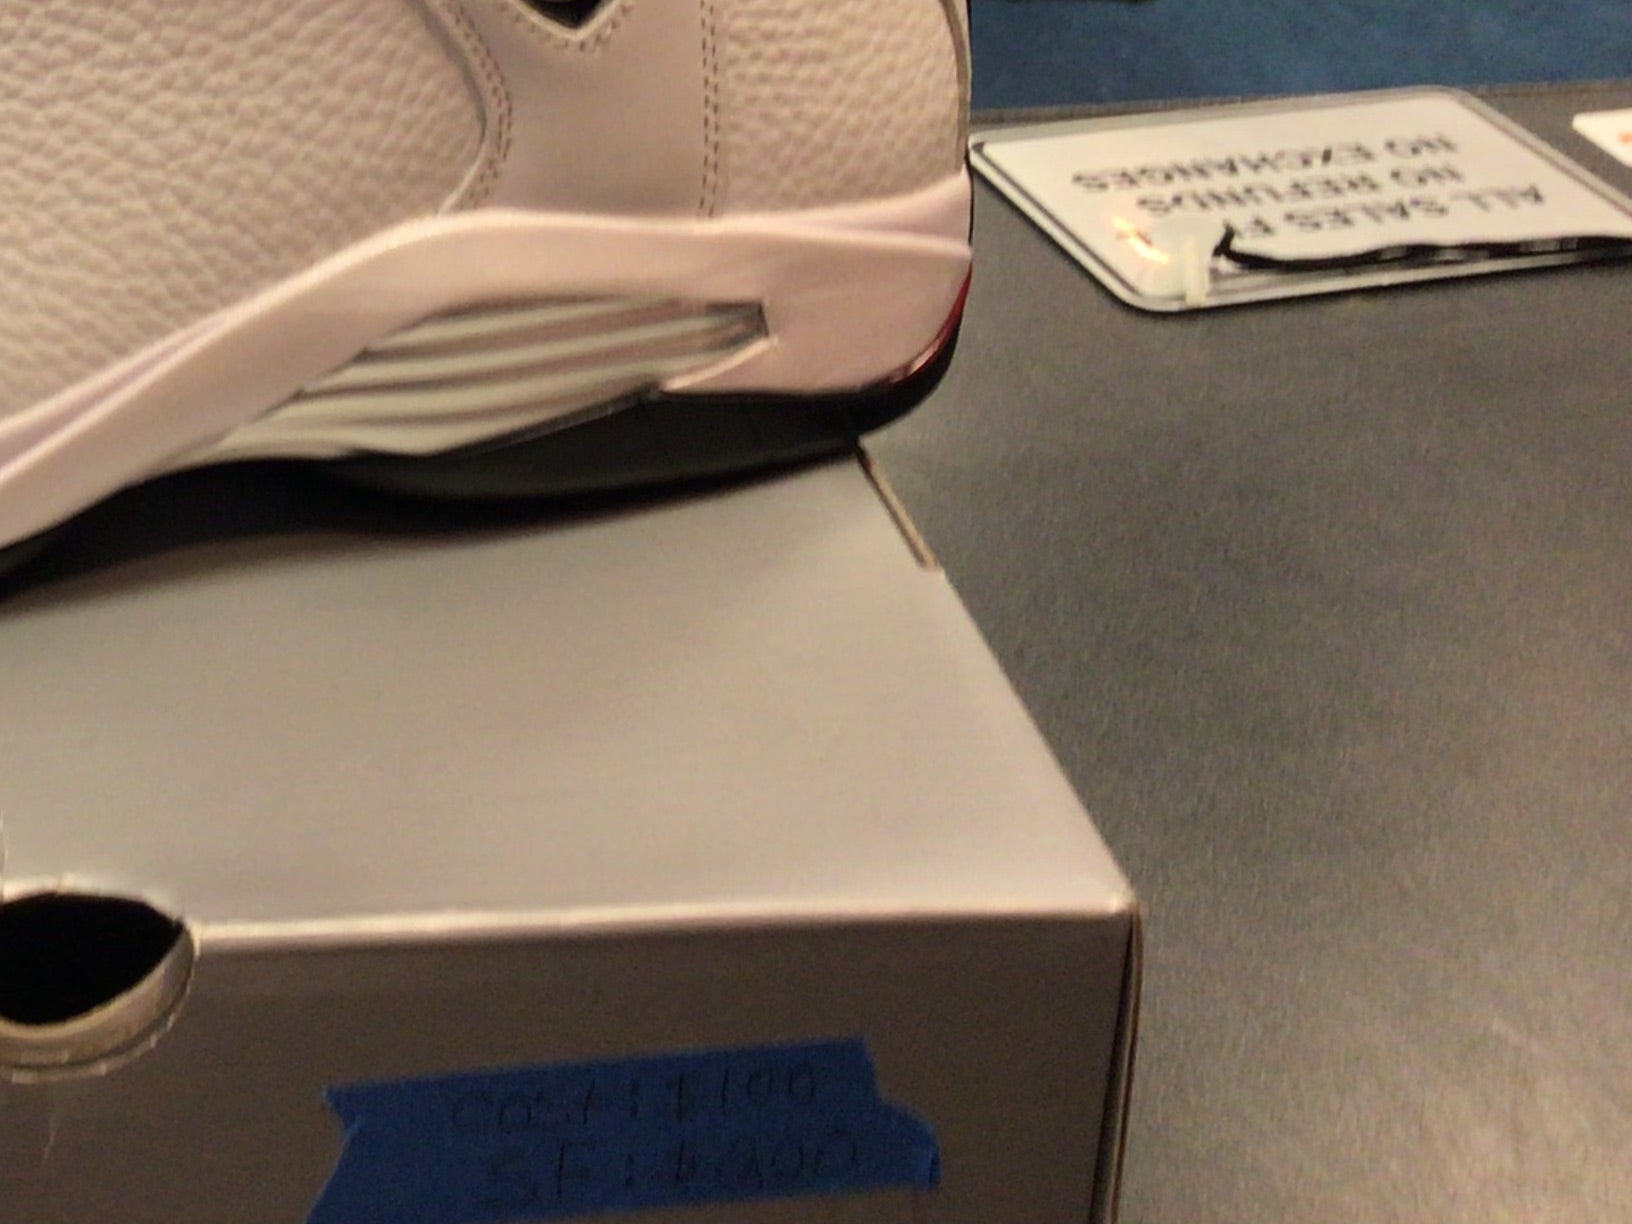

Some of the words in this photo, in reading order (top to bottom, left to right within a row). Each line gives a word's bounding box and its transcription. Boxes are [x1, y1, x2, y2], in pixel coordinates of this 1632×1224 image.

[1384, 136, 1457, 160] NO
[1072, 141, 1374, 192] EXCHANGES
[1390, 163, 1464, 188] NO
[1136, 173, 1379, 214] REFUNDS
[1449, 184, 1544, 212] ALL
[1283, 197, 1449, 232] SALES
